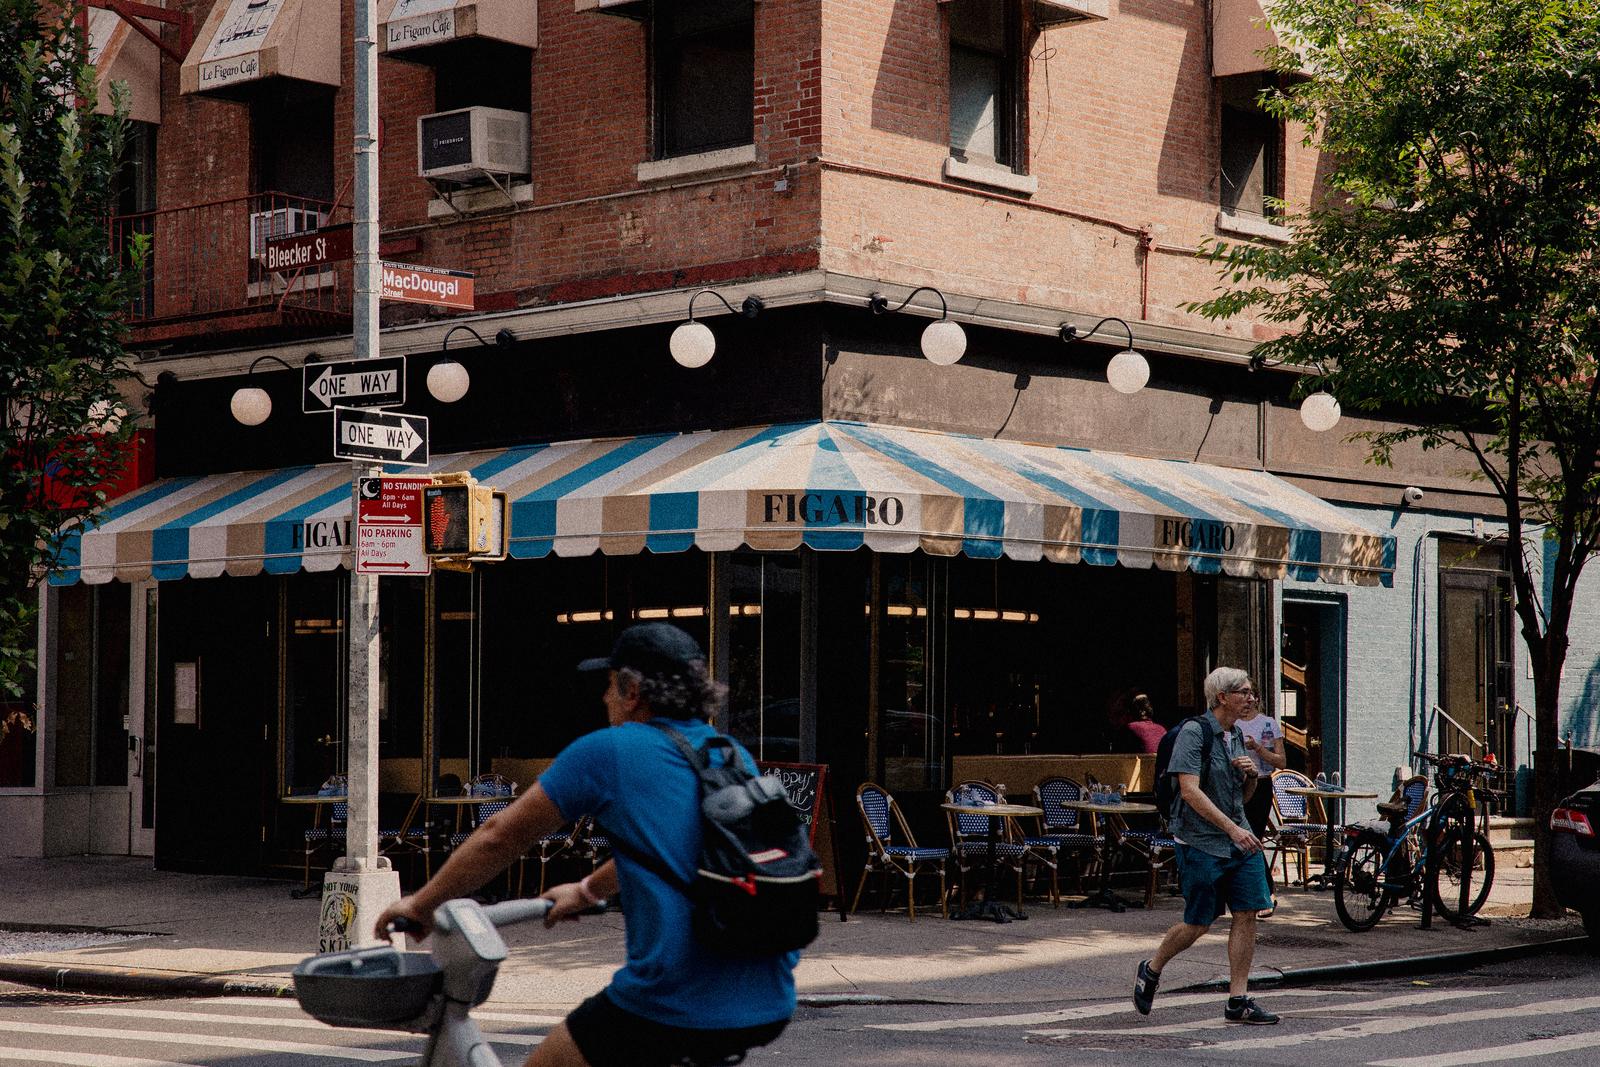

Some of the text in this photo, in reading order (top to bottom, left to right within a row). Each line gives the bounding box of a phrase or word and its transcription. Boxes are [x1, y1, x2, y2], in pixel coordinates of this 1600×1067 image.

[390, 28, 401, 42] Le
[403, 24, 431, 41] Figaro
[202, 67, 213, 81] Le
[214, 64, 239, 81] Figaro
[268, 237, 327, 269] Bleecker St
[383, 269, 459, 299] MacDougal
[383, 287, 404, 298] Street
[319, 372, 391, 397] ONE WAY
[348, 424, 414, 449] ONE WAY
[383, 482, 392, 490] NO
[382, 493, 396, 501] 6pm
[382, 501, 407, 510] All Days
[762, 493, 904, 526] FIGARO
[361, 528, 412, 538] NO PARKING
[1162, 519, 1235, 552] FIGARO
[360, 540, 375, 548] 6am
[381, 541, 396, 550] 6pm
[371, 550, 387, 559] Days
[323, 882, 359, 895] NOT YOUR
